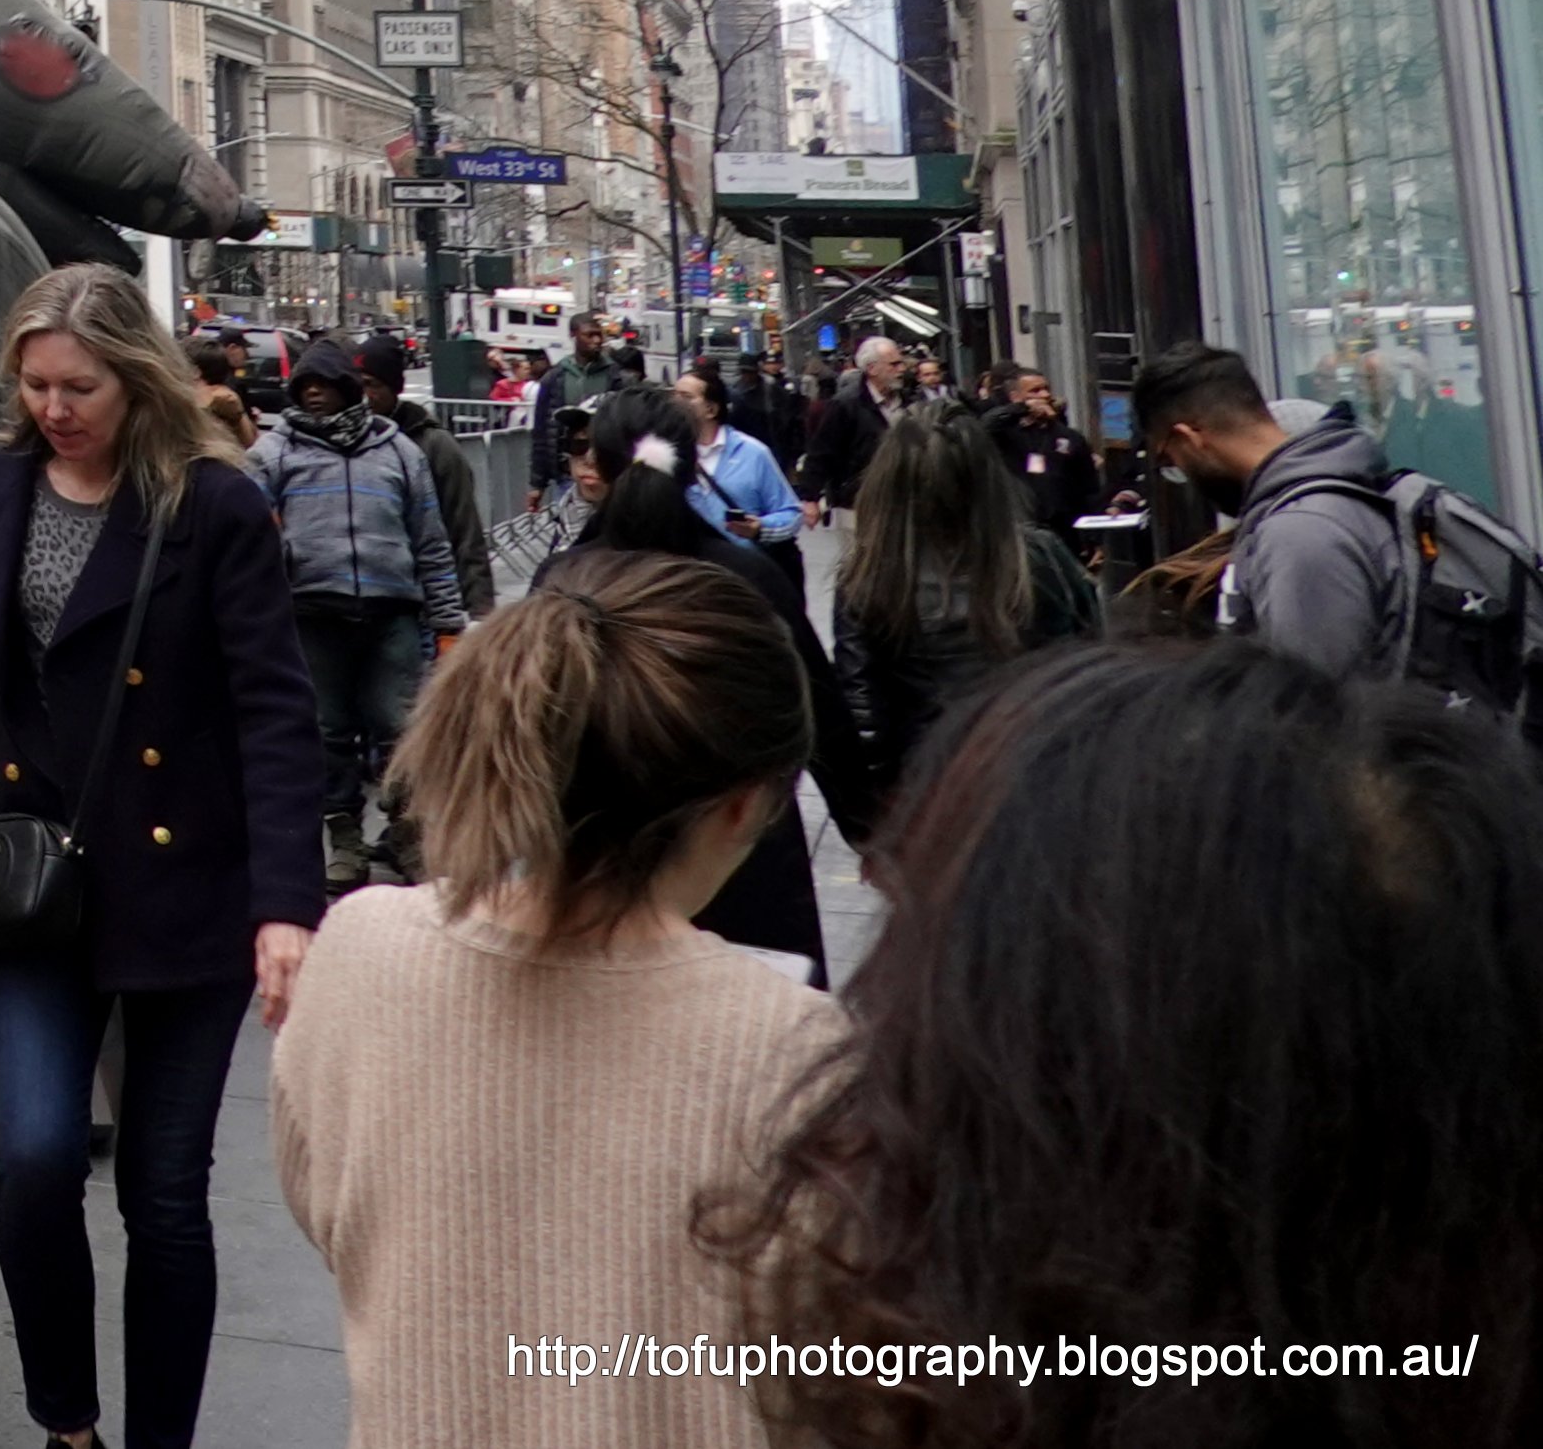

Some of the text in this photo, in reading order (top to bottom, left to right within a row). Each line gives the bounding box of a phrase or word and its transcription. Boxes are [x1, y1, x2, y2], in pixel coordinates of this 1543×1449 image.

[384, 21, 454, 36] PASSENGER
[385, 41, 454, 54] CARS ONLY
[458, 160, 558, 178] West 33rd St
[805, 178, 910, 191] Panera Bread
[400, 186, 457, 199] ONE WAY
